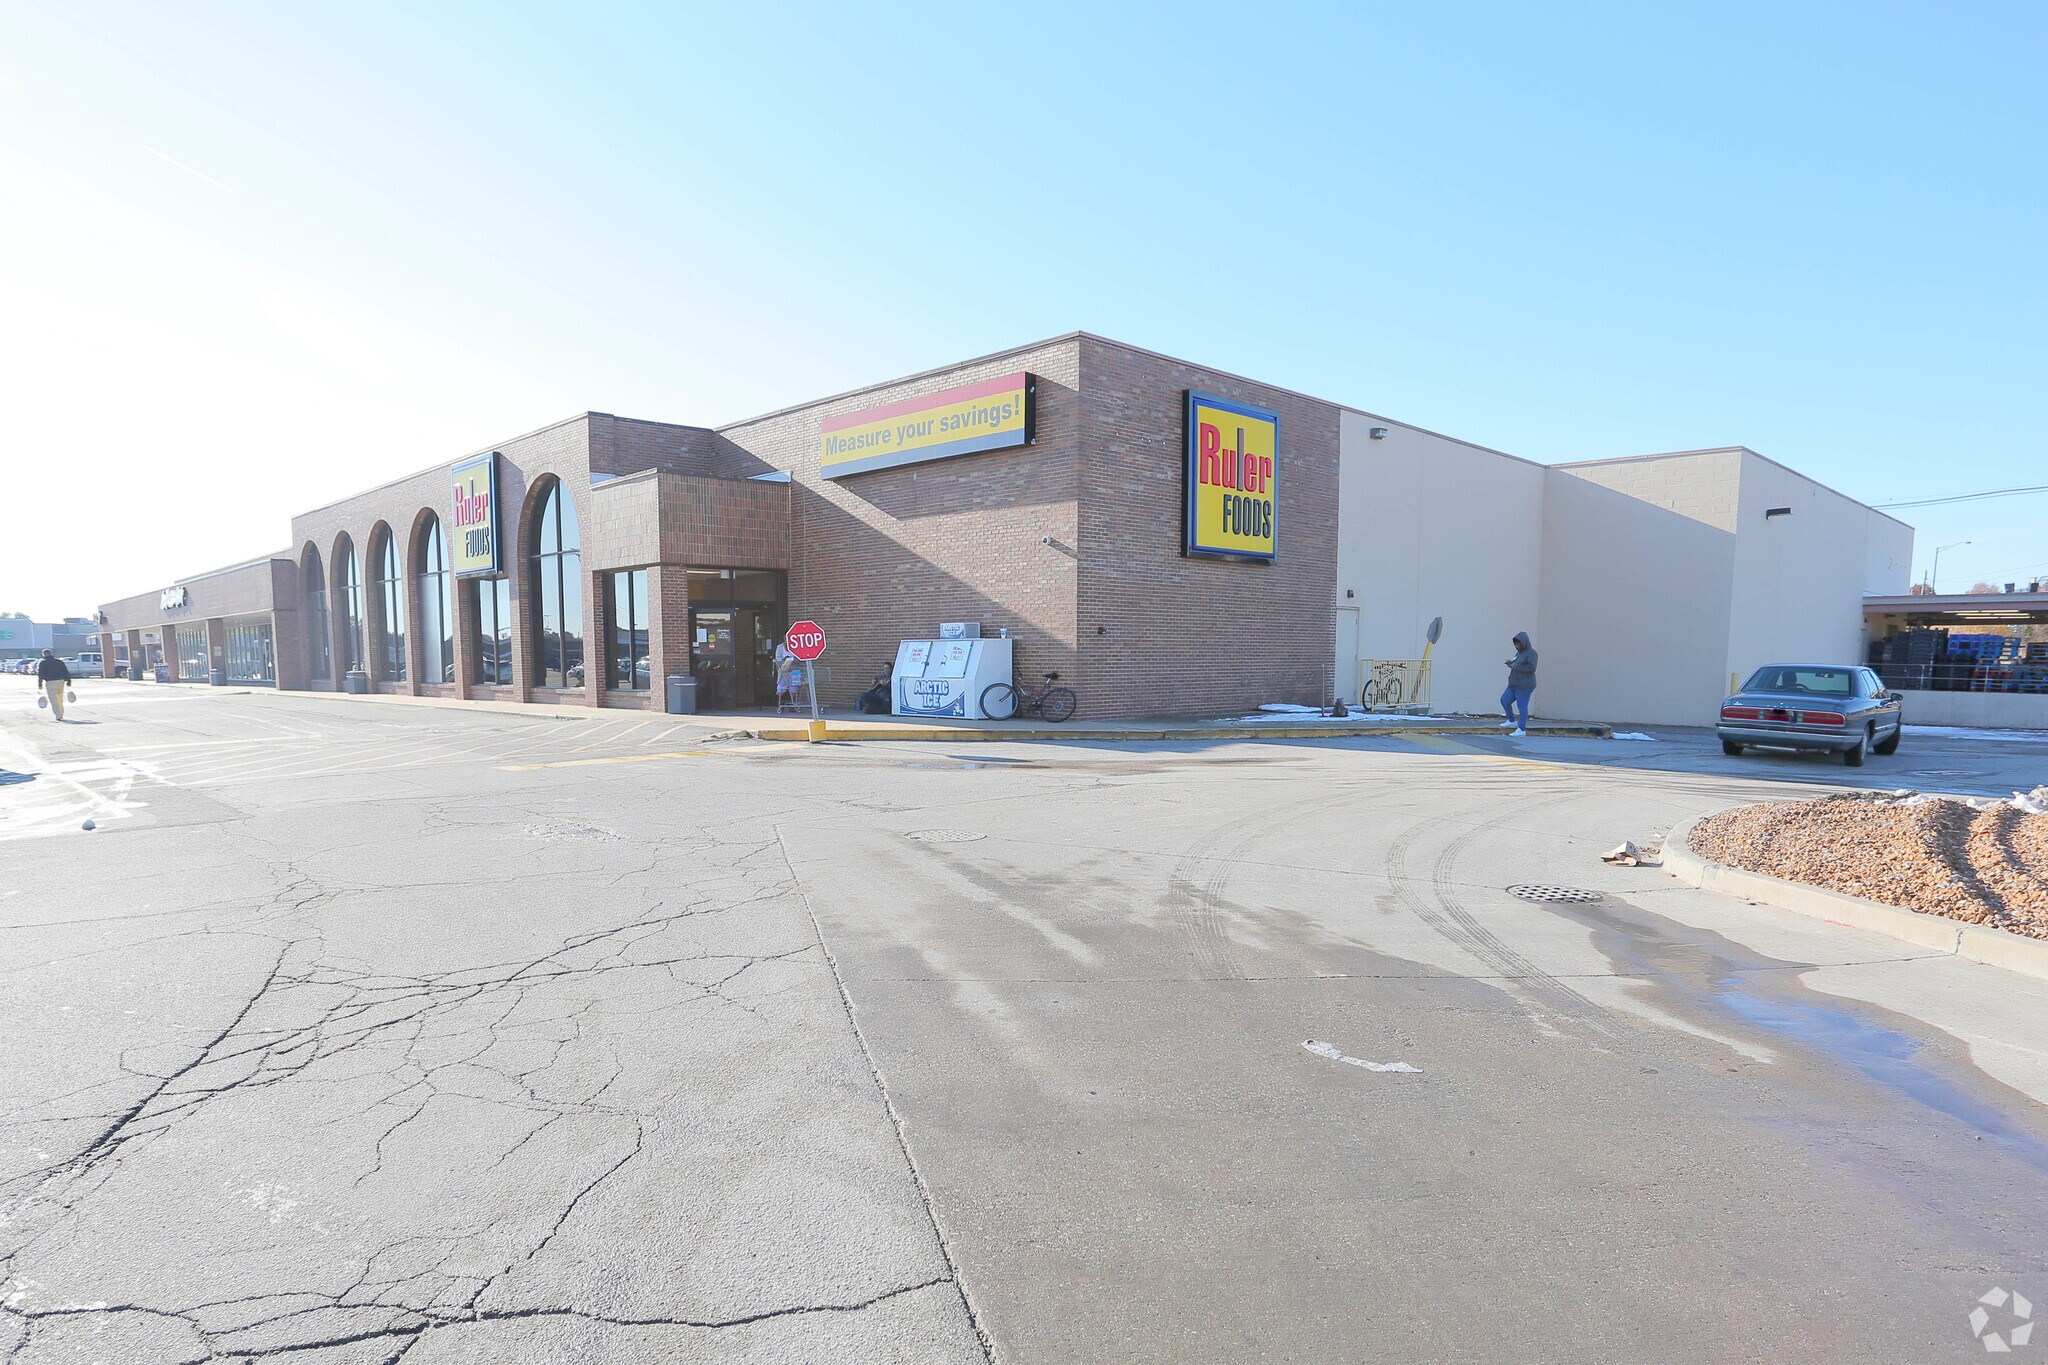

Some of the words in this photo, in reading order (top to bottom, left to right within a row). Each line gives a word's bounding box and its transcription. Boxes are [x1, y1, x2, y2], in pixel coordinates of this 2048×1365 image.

[825, 428, 892, 456] Measure
[896, 419, 935, 447] your
[939, 394, 1020, 432] savings!
[1200, 423, 1272, 493] Ruler
[453, 477, 489, 527] Ruler
[1223, 494, 1272, 539] FOODS
[465, 525, 490, 558] FOODS
[789, 633, 822, 649] STOP
[913, 680, 949, 696] ARCTIC
[922, 694, 941, 709] ICE
